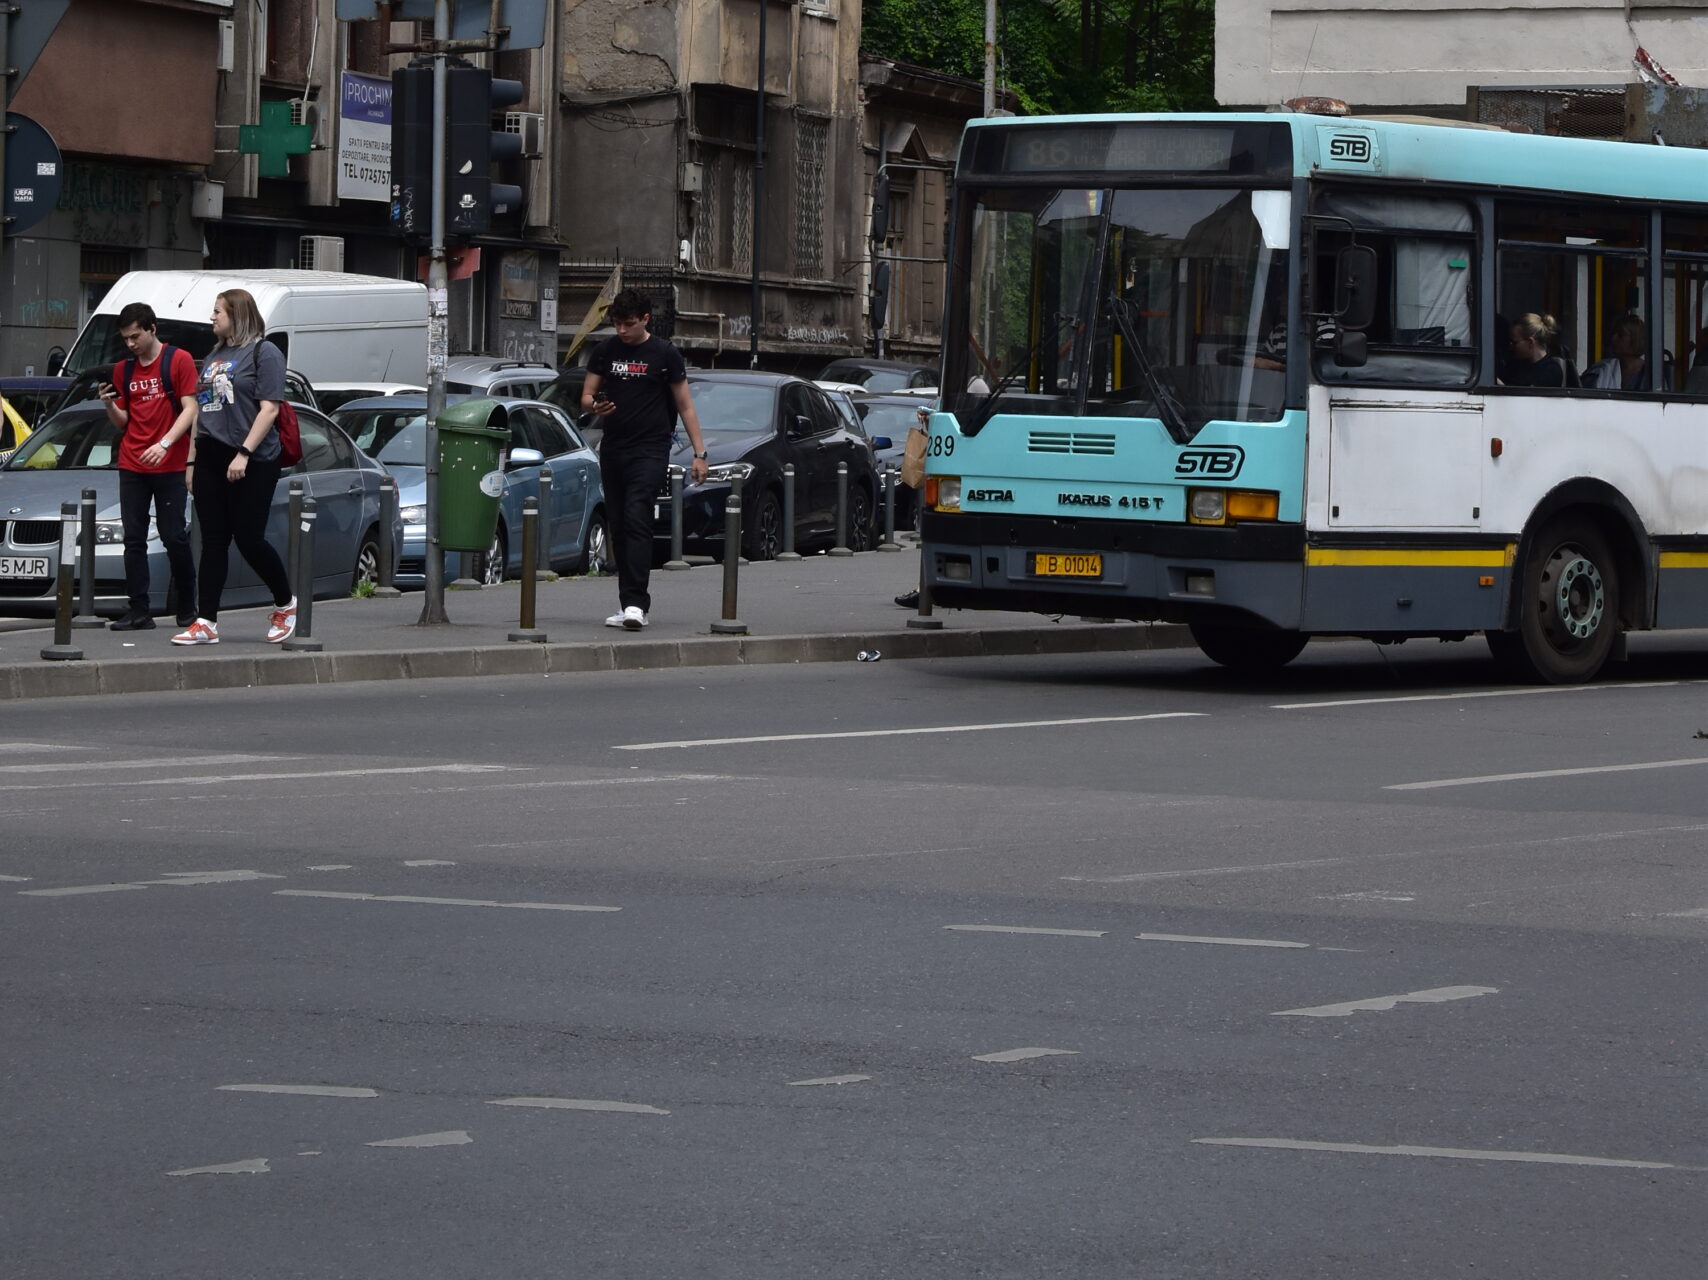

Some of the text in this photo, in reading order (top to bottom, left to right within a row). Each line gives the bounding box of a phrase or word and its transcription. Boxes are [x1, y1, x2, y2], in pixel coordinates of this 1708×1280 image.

[1028, 138, 1070, 166] 86
[1330, 138, 1367, 157] STB
[344, 162, 391, 185] TEL 0725757
[611, 362, 648, 373] TOMMY
[129, 378, 162, 391] GUE
[1175, 450, 1237, 474] STB
[967, 489, 1015, 502] ASTRA
[1058, 493, 1164, 510] IKARUS 415 T
[13, 560, 45, 574] MJR
[1048, 556, 1098, 574] B 01014
